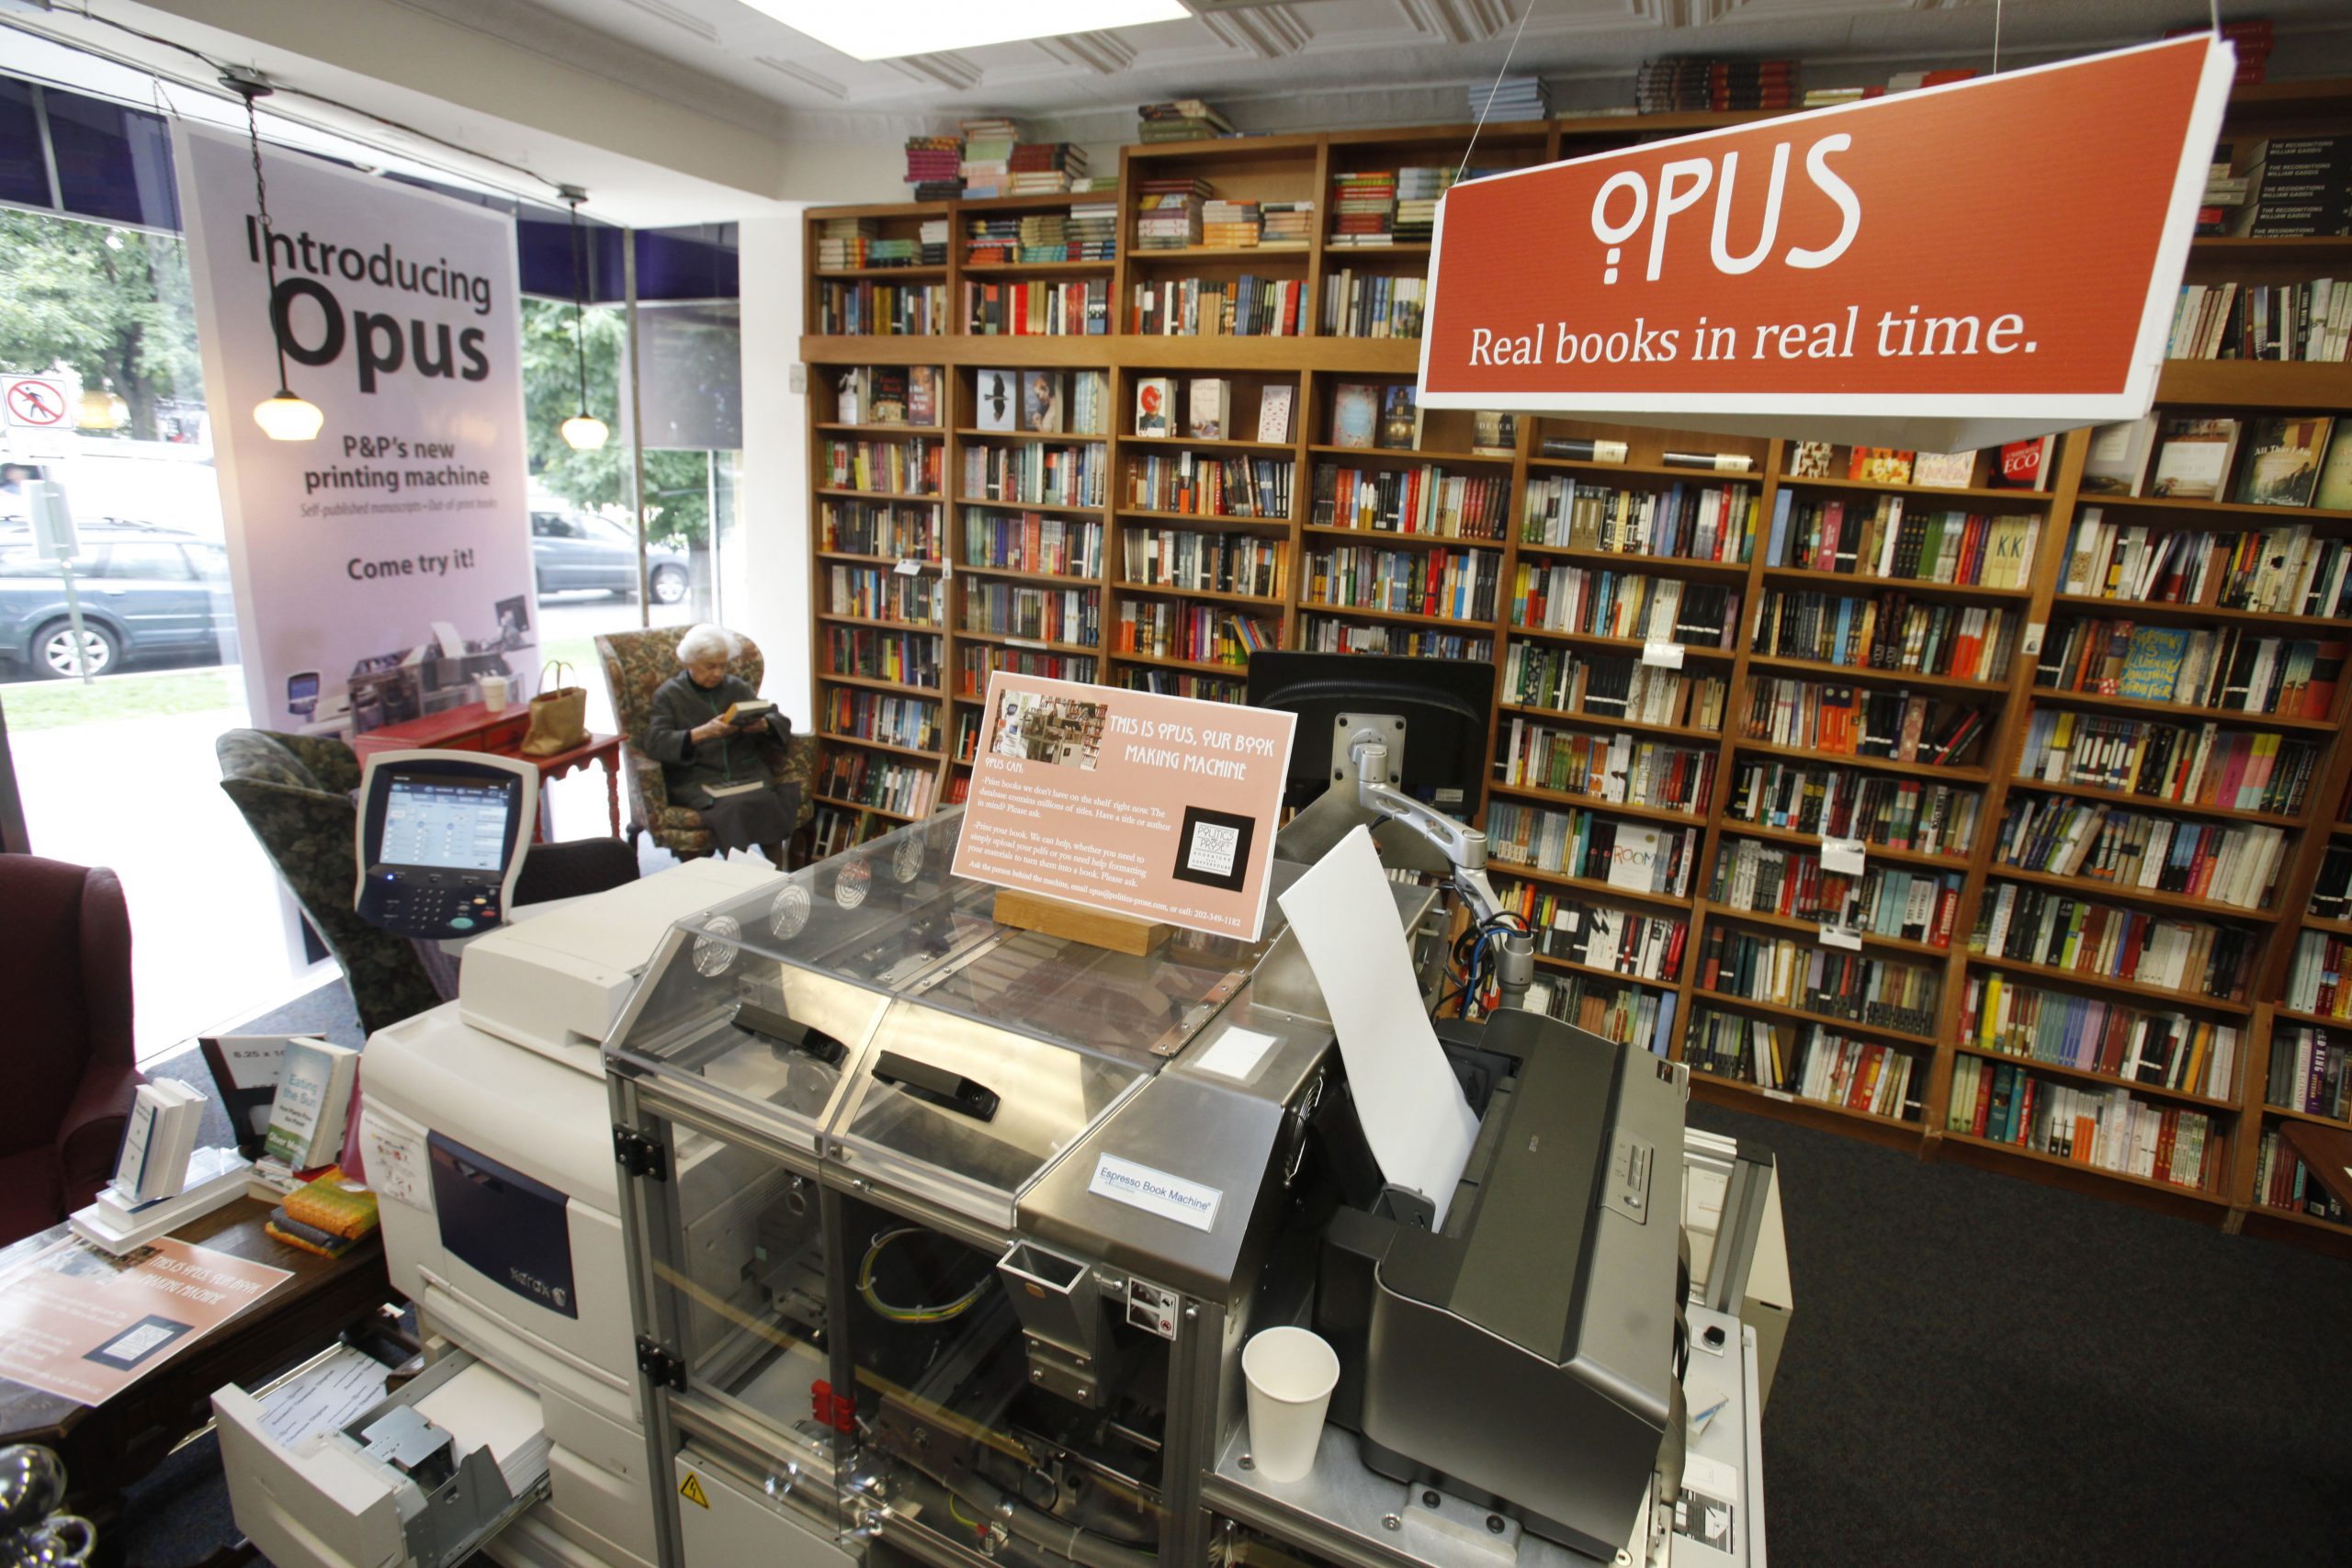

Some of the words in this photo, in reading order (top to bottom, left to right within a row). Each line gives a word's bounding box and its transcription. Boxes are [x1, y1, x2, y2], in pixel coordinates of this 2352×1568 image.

[1590, 131, 1861, 285] OPUS
[246, 214, 492, 315] Introducing
[269, 276, 490, 394] Opus
[1468, 323, 1544, 367] Real
[1555, 317, 1679, 363] books
[1690, 316, 1736, 361] in
[1751, 304, 1860, 360] real
[1875, 304, 2039, 357] time.
[343, 434, 408, 458] P&P's
[414, 442, 455, 458] new
[304, 465, 399, 494] printing
[404, 464, 490, 487] machine
[2003, 452, 2040, 474] ECO
[346, 558, 413, 581] Come
[418, 554, 448, 576] try
[453, 548, 475, 569] it!
[1110, 715, 1137, 735] THIS
[1141, 719, 1154, 737] IS
[1158, 723, 1197, 746] OPUS,
[1202, 729, 1232, 750] OUR
[1235, 734, 1274, 757] BOOK
[985, 757, 1004, 770] OPUS
[1124, 744, 1181, 770] MAKING
[1183, 753, 1247, 781] MACHINE
[979, 787, 1008, 799] database
[1008, 794, 1036, 805] contains
[1036, 799, 1064, 810] millions
[1095, 809, 1114, 820] Have
[1122, 815, 1136, 824] title
[1147, 820, 1171, 831] author
[1001, 779, 1022, 791] books
[1053, 789, 1069, 799] have
[1081, 795, 1092, 804] the
[1093, 796, 1112, 807] shelf
[1114, 801, 1131, 812] right
[1150, 807, 1166, 818] The
[1007, 804, 1028, 815] Please
[992, 826, 1008, 835] your
[1030, 832, 1041, 841] We
[1042, 837, 1054, 845] can
[1073, 842, 1102, 854] whether
[1102, 849, 1116, 858] you
[1117, 852, 1136, 862] need
[1198, 826, 1235, 840] POLITICS
[967, 844, 983, 853] your
[984, 848, 1012, 860] materials
[1023, 856, 1038, 865] turn
[1039, 859, 1057, 869] them
[1057, 863, 1072, 874] into
[1101, 872, 1124, 884] Please
[970, 833, 992, 844] simply
[993, 838, 1015, 849] upload
[1016, 842, 1033, 852] your
[1058, 852, 1072, 861] you
[1073, 854, 1091, 864] need
[1091, 856, 1107, 870] help
[1108, 861, 1148, 879] formatting
[1614, 845, 1657, 869] ROOM
[969, 860, 981, 869] Ask
[991, 865, 1012, 875] person
[1012, 869, 1033, 881] behind
[1070, 884, 1088, 893] email
[1193, 909, 1241, 927] 202-349-1182
[2314, 1050, 2326, 1072] KING
[283, 1088, 298, 1100] the
[301, 1094, 317, 1108] Sun
[289, 1074, 319, 1096] Eating
[1101, 1167, 1141, 1188] Espresso
[1142, 1181, 1167, 1197] Book
[149, 1256, 176, 1270] THIS
[141, 1273, 184, 1293] MAKING
[176, 1285, 227, 1304] MACHINE
